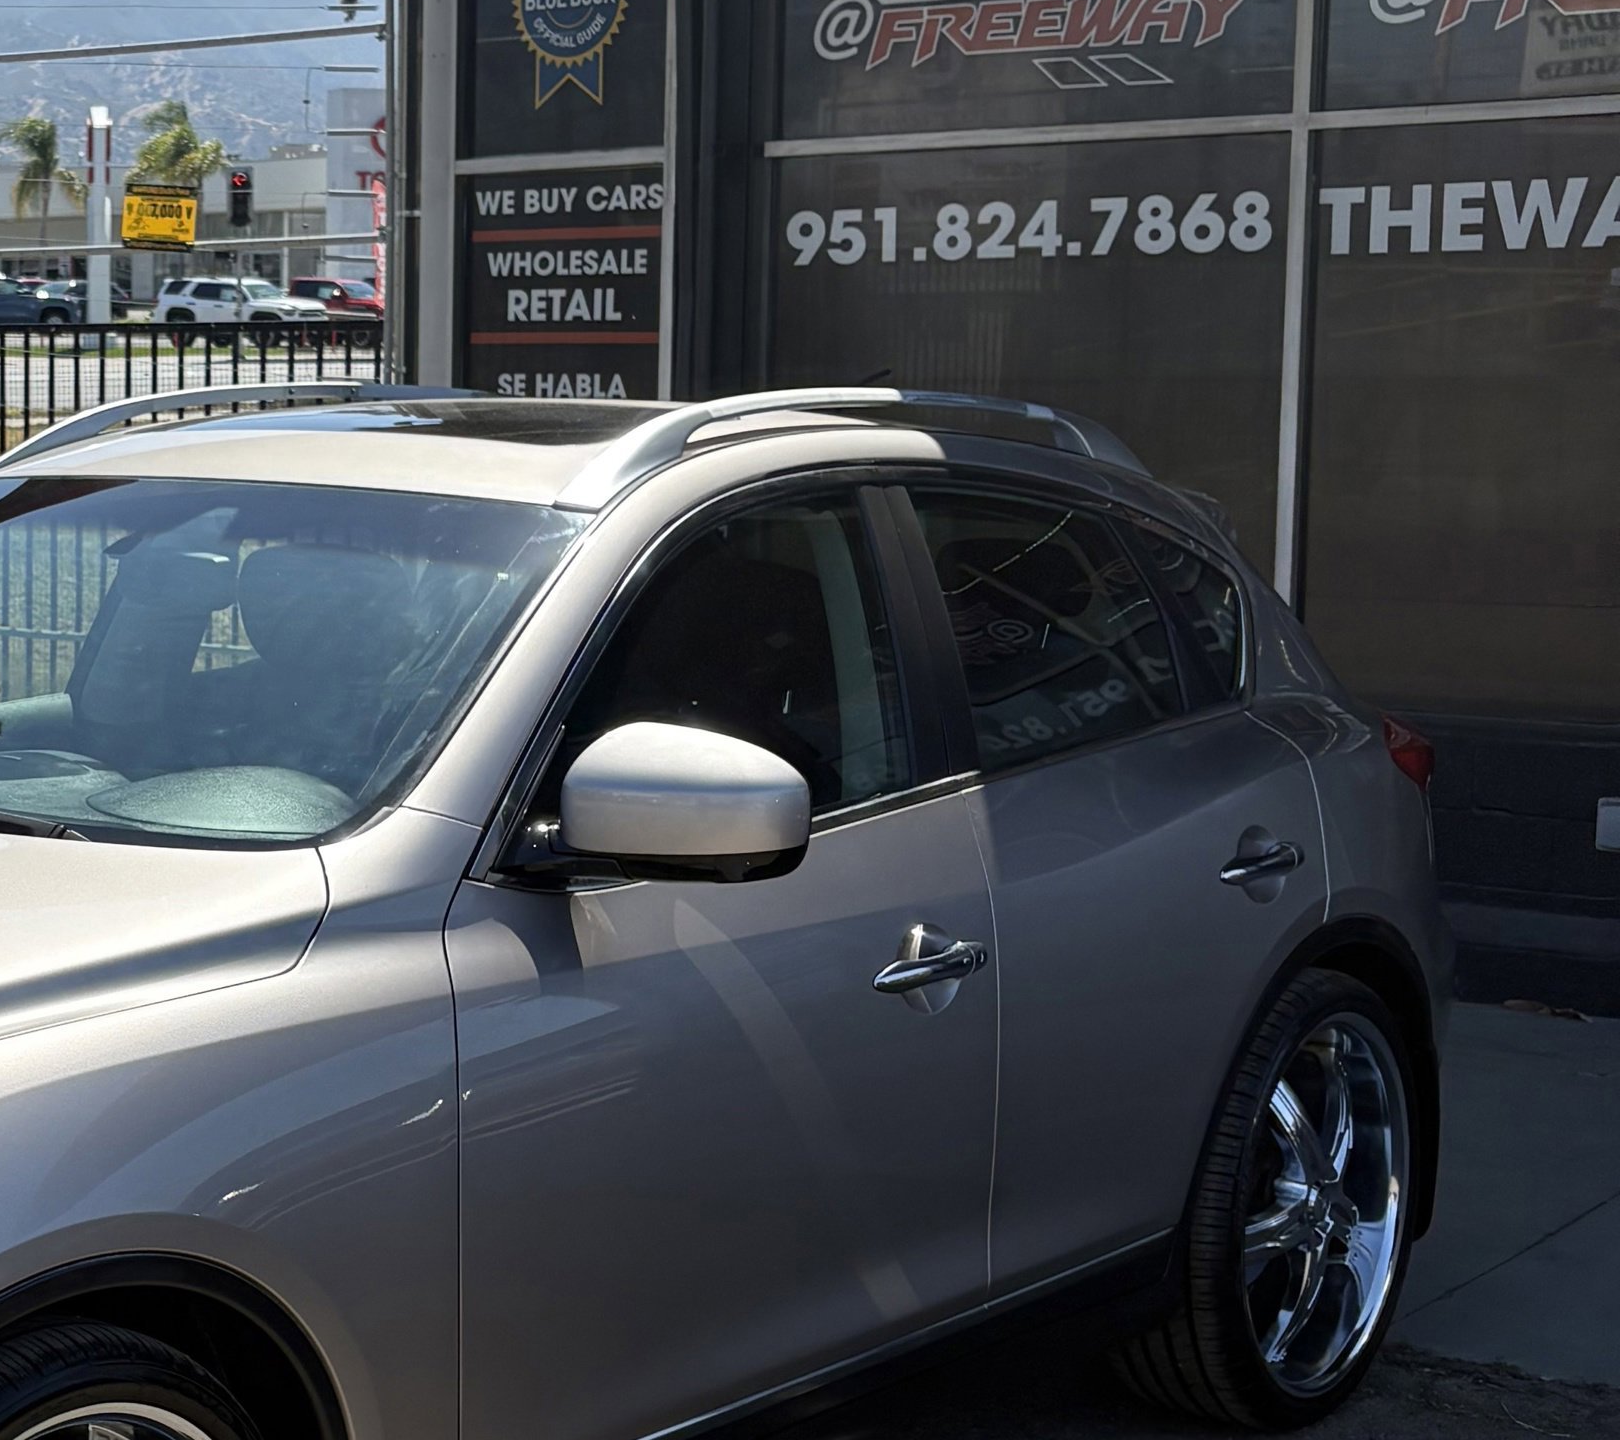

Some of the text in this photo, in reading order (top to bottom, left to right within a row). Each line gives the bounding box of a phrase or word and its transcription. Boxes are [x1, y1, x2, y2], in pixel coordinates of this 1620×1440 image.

[533, 12, 607, 48] OFFICIAL GUIDE
[476, 182, 664, 217] WE BUY CARS
[787, 191, 1273, 266] 951.824.7868
[487, 248, 648, 278] WHOLESALE
[507, 287, 622, 323] RETAIL
[497, 372, 627, 399] SE HABLA
